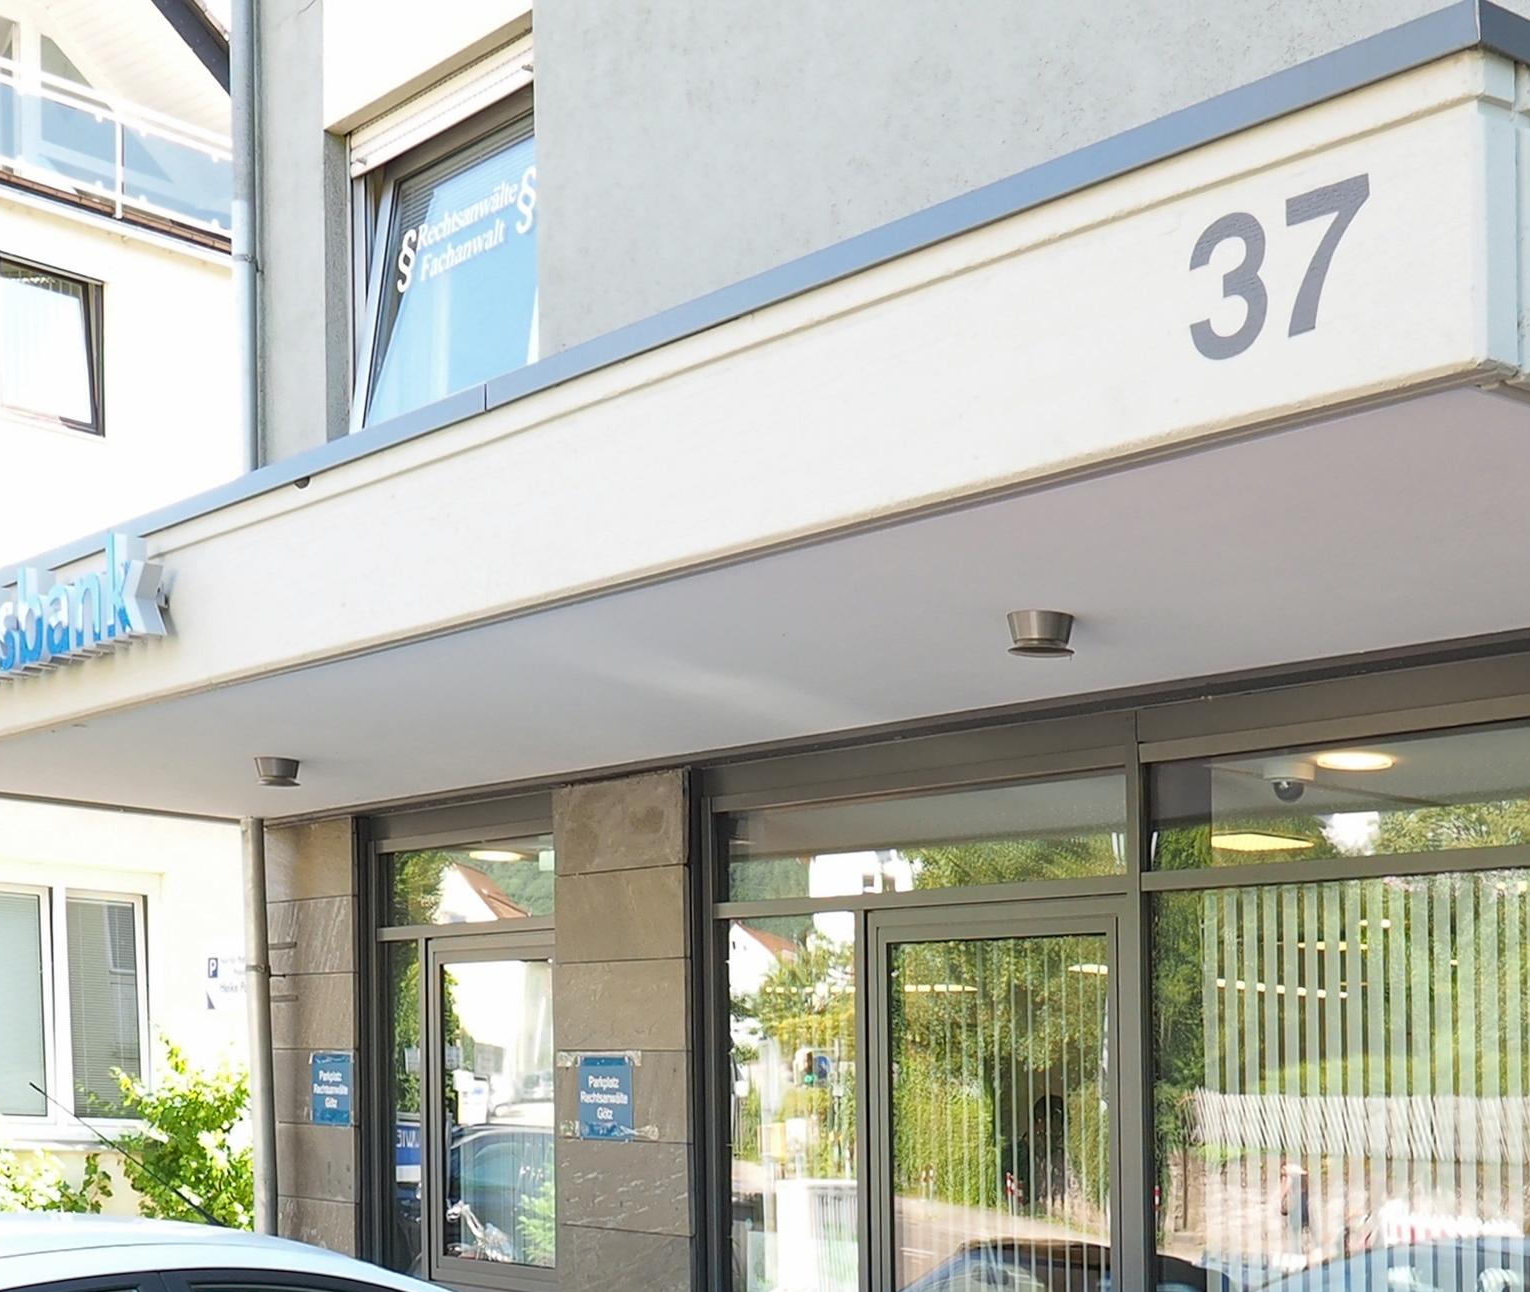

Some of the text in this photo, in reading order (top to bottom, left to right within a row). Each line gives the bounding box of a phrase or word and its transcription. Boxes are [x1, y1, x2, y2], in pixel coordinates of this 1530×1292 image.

[419, 180, 518, 249] Rechtsanwälte
[420, 219, 505, 283] Fachanwalt
[1189, 173, 1370, 360] 37
